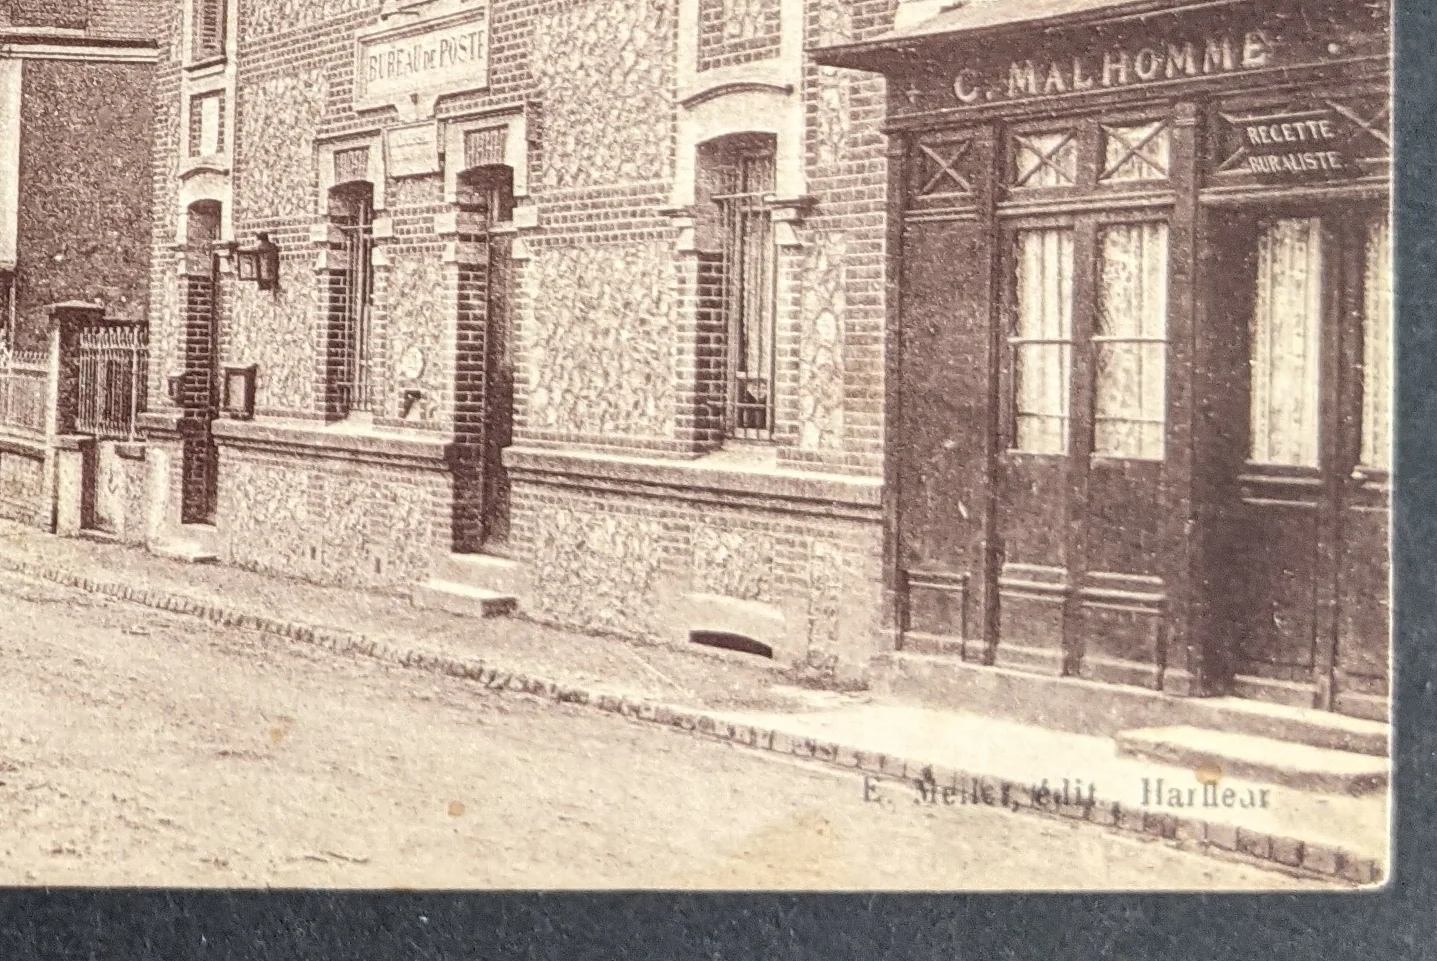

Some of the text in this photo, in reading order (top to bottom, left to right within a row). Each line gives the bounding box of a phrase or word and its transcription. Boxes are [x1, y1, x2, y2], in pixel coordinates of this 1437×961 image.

[368, 44, 422, 82] BUREAU
[439, 30, 485, 67] POSTE
[954, 30, 1269, 102] C. MALHOMME
[1247, 120, 1335, 145] RECETTE
